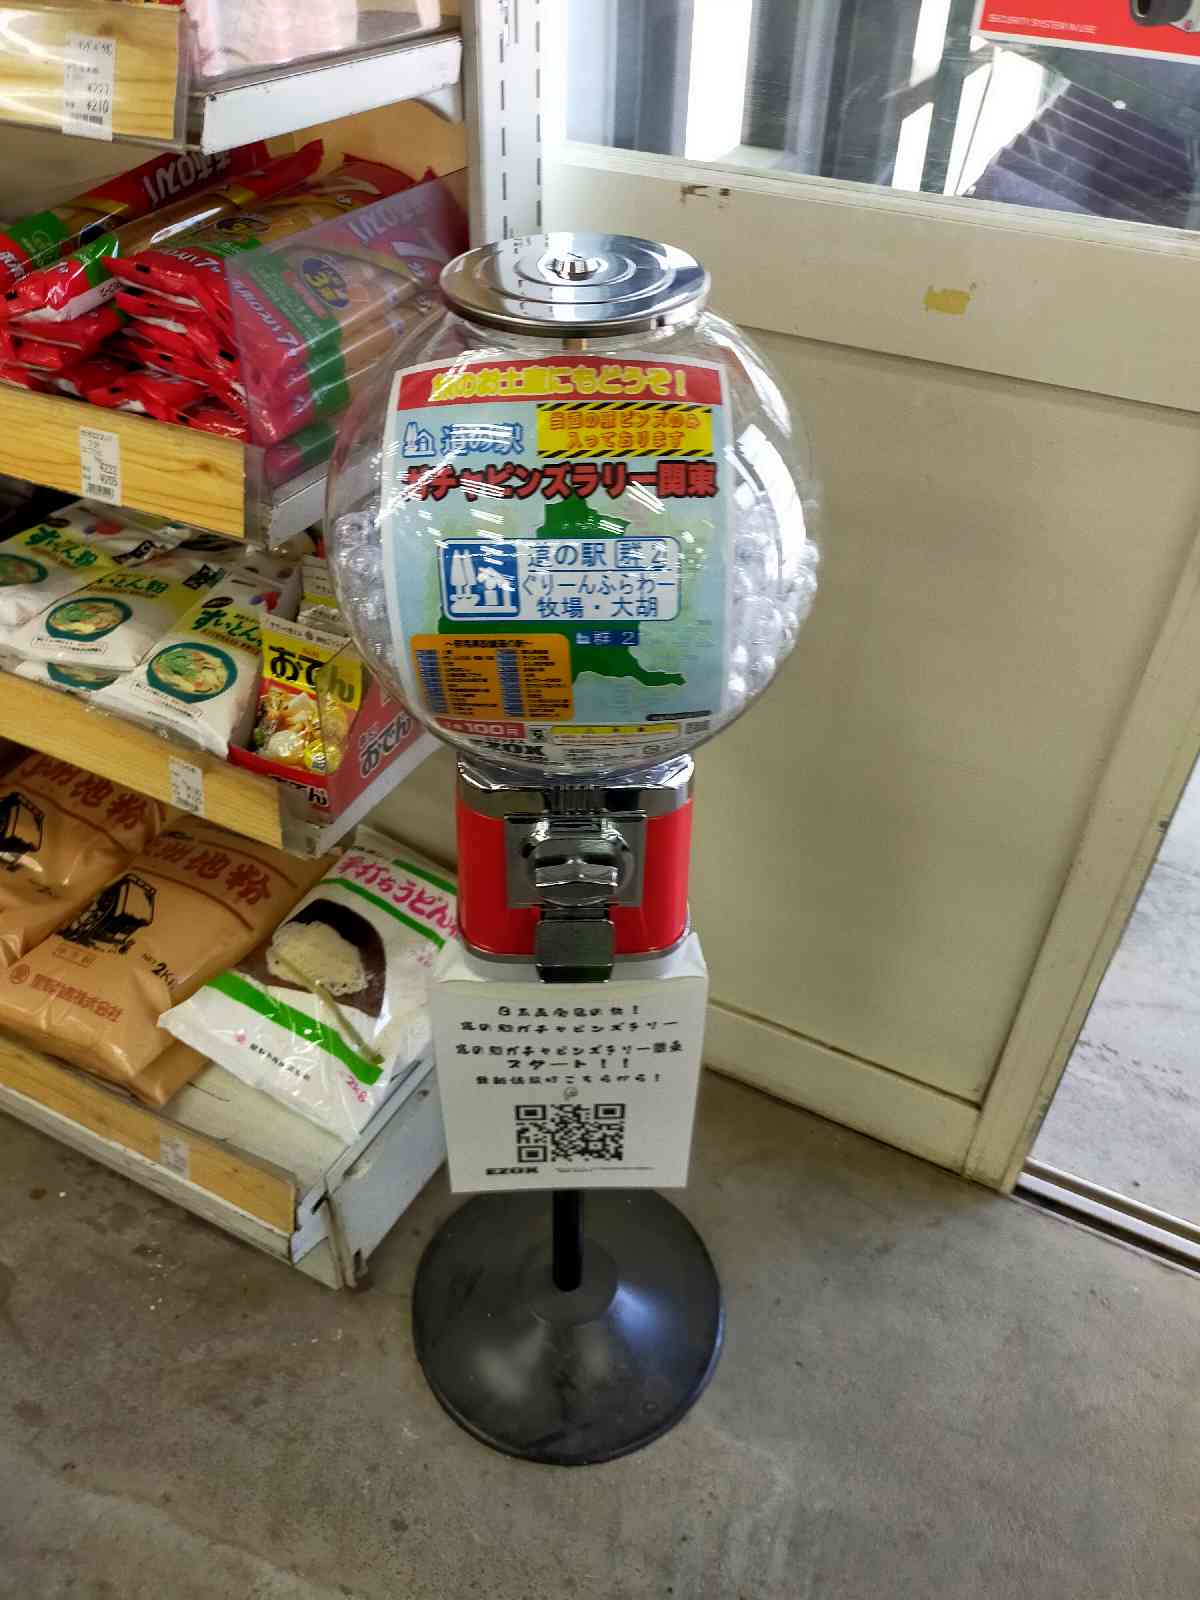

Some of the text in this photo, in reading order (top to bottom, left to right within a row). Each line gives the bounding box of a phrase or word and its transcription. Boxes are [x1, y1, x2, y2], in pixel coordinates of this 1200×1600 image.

[528, 542, 607, 567] 道の駅
[522, 574, 676, 596] ぐりーんふらわー
[537, 597, 659, 619] 牧場・大胡
